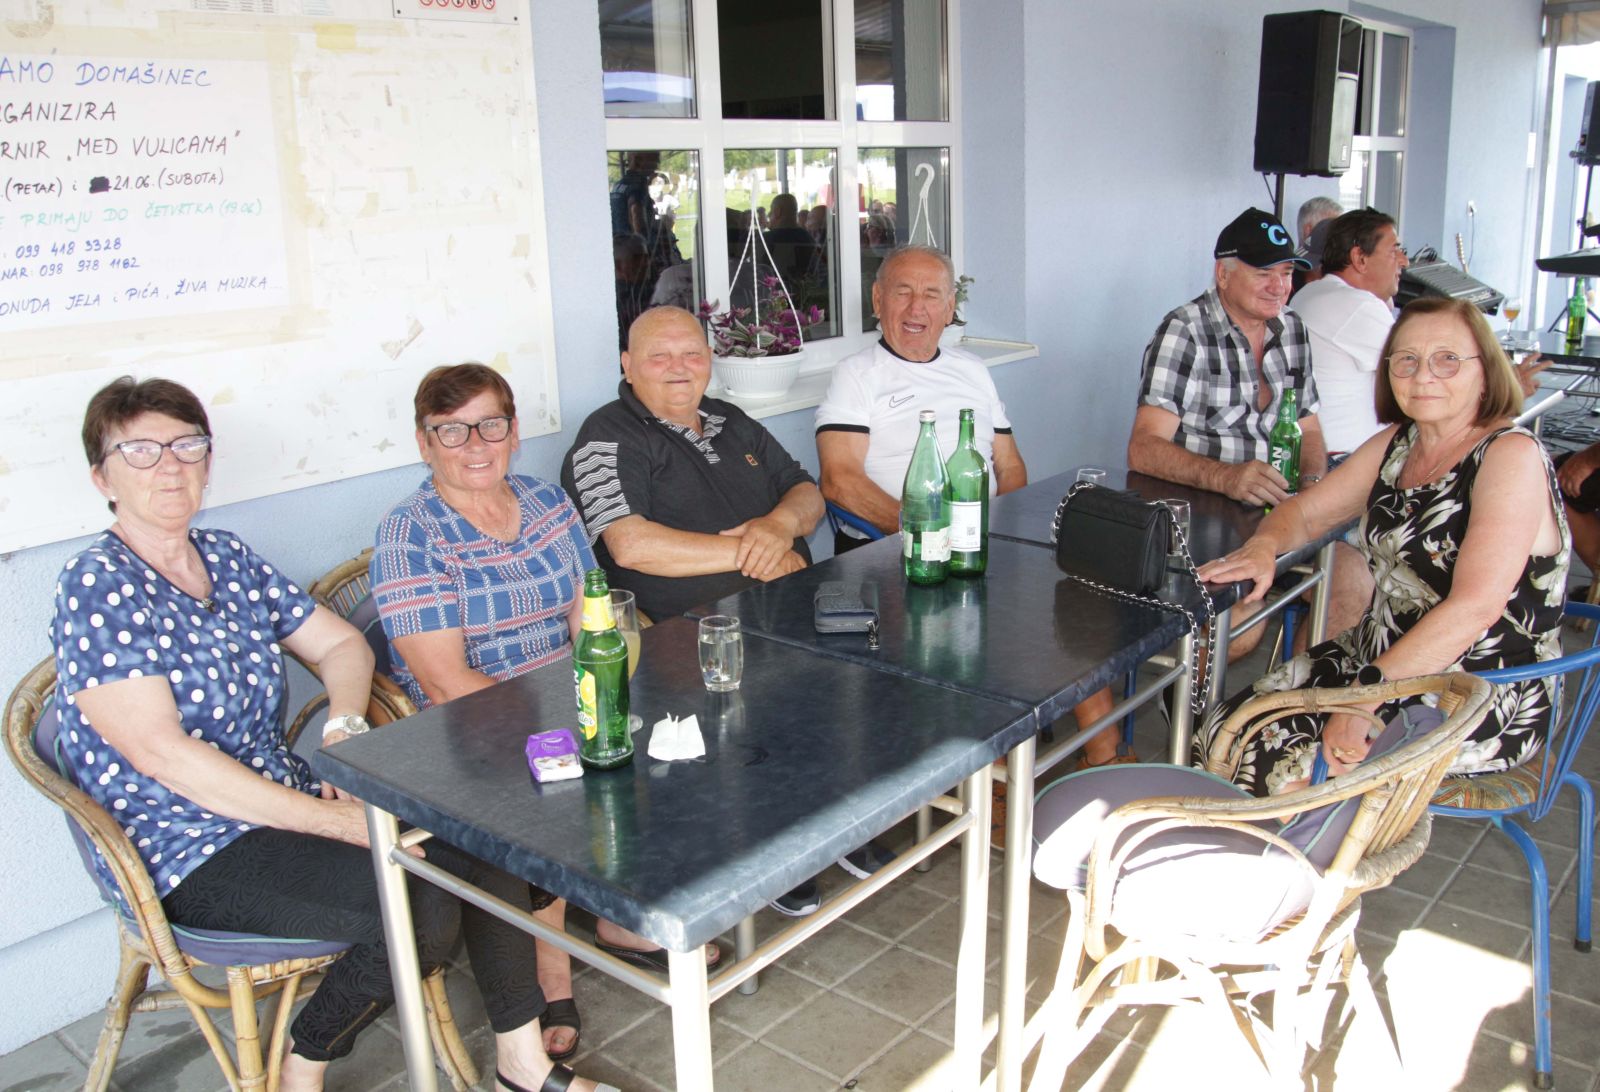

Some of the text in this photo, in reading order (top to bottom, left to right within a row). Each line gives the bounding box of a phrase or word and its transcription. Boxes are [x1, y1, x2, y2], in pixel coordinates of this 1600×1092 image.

[75, 62, 212, 87] DOMAŠINEC
[0, 101, 117, 124] GANIZIRA
[5, 177, 62, 201] (PETAK)
[157, 167, 224, 189] (SUBOTA)
[20, 209, 92, 232] PRIMAJU
[103, 207, 129, 222] DO
[145, 200, 214, 218] ČETVRTKA
[51, 241, 76, 256] 418
[85, 236, 122, 252] 3328
[39, 262, 64, 277] 098
[65, 293, 101, 310] JELA
[1271, 445, 1283, 472] AN
